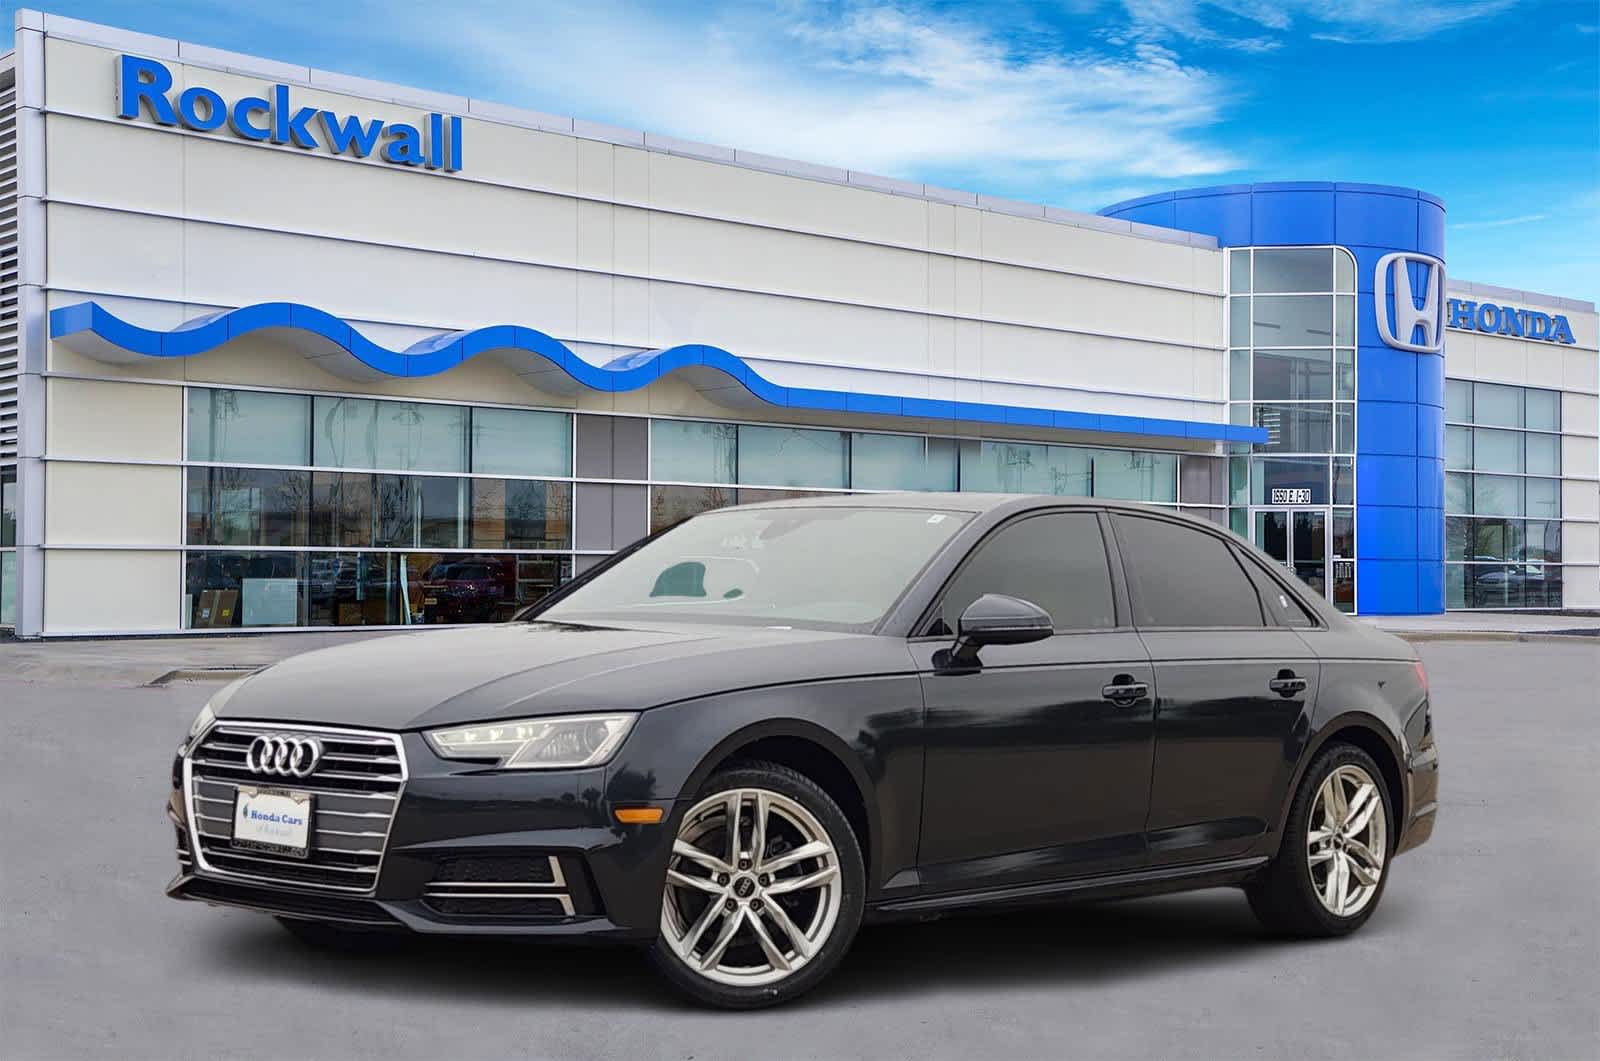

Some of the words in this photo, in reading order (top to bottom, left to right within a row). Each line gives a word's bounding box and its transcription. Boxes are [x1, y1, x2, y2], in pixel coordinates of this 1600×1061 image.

[117, 54, 463, 172] Rockwall
[1447, 298, 1577, 344] HONDA
[251, 810, 280, 823] Honda
[282, 814, 303, 825] Cars
